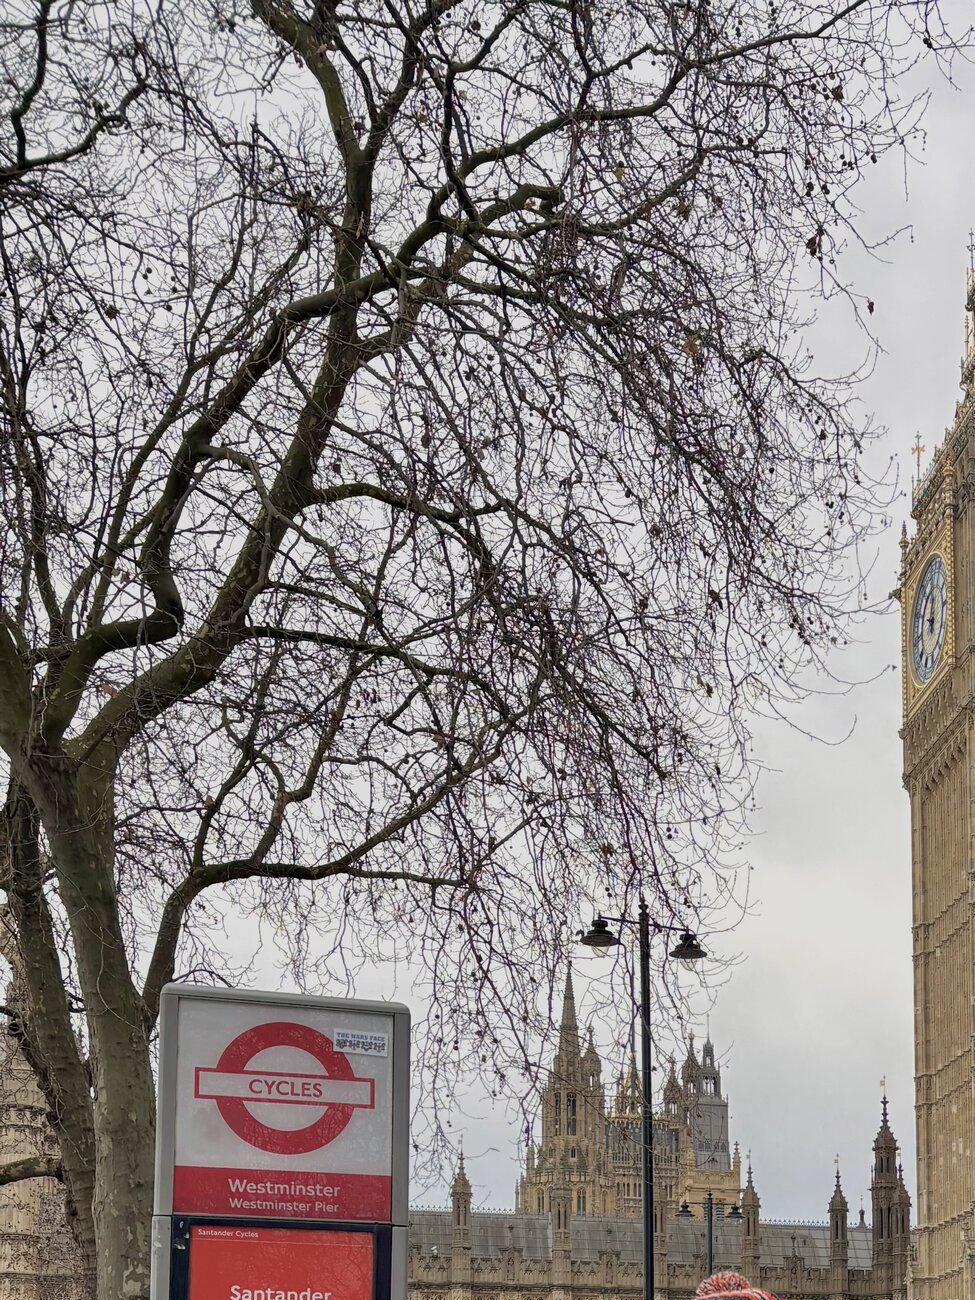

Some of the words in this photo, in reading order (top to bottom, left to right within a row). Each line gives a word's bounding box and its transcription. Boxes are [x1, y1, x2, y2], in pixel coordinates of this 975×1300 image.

[248, 1079, 323, 1098] CYCLES
[228, 1178, 341, 1197] Westminster
[229, 1198, 312, 1211] Westminster
[314, 1201, 340, 1212] Pier
[197, 1228, 234, 1237] Santander
[235, 1230, 259, 1238] Cycles
